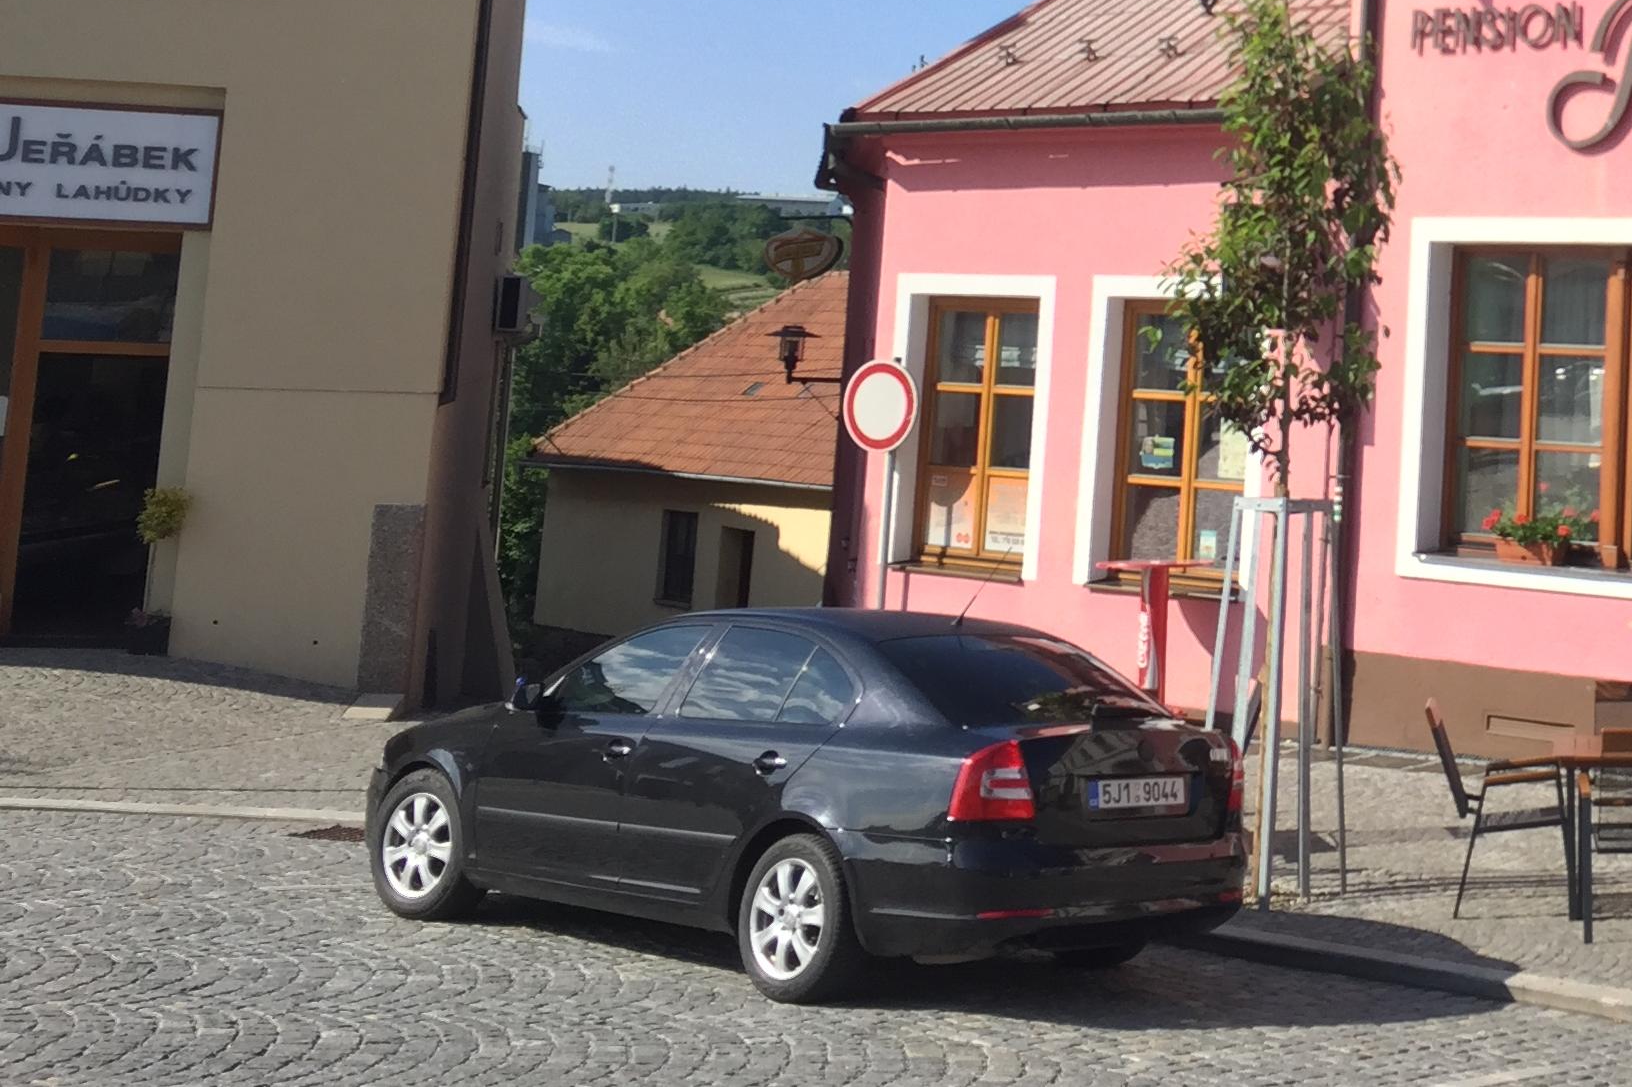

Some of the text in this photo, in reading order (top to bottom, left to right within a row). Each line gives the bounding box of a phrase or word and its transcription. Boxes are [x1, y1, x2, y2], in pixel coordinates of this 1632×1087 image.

[1410, 1, 1584, 56] PENSION
[0, 116, 199, 172] JEŘÁBEK
[56, 180, 193, 204] LAHŮDKY
[1102, 780, 1179, 805] 5J1 9044
